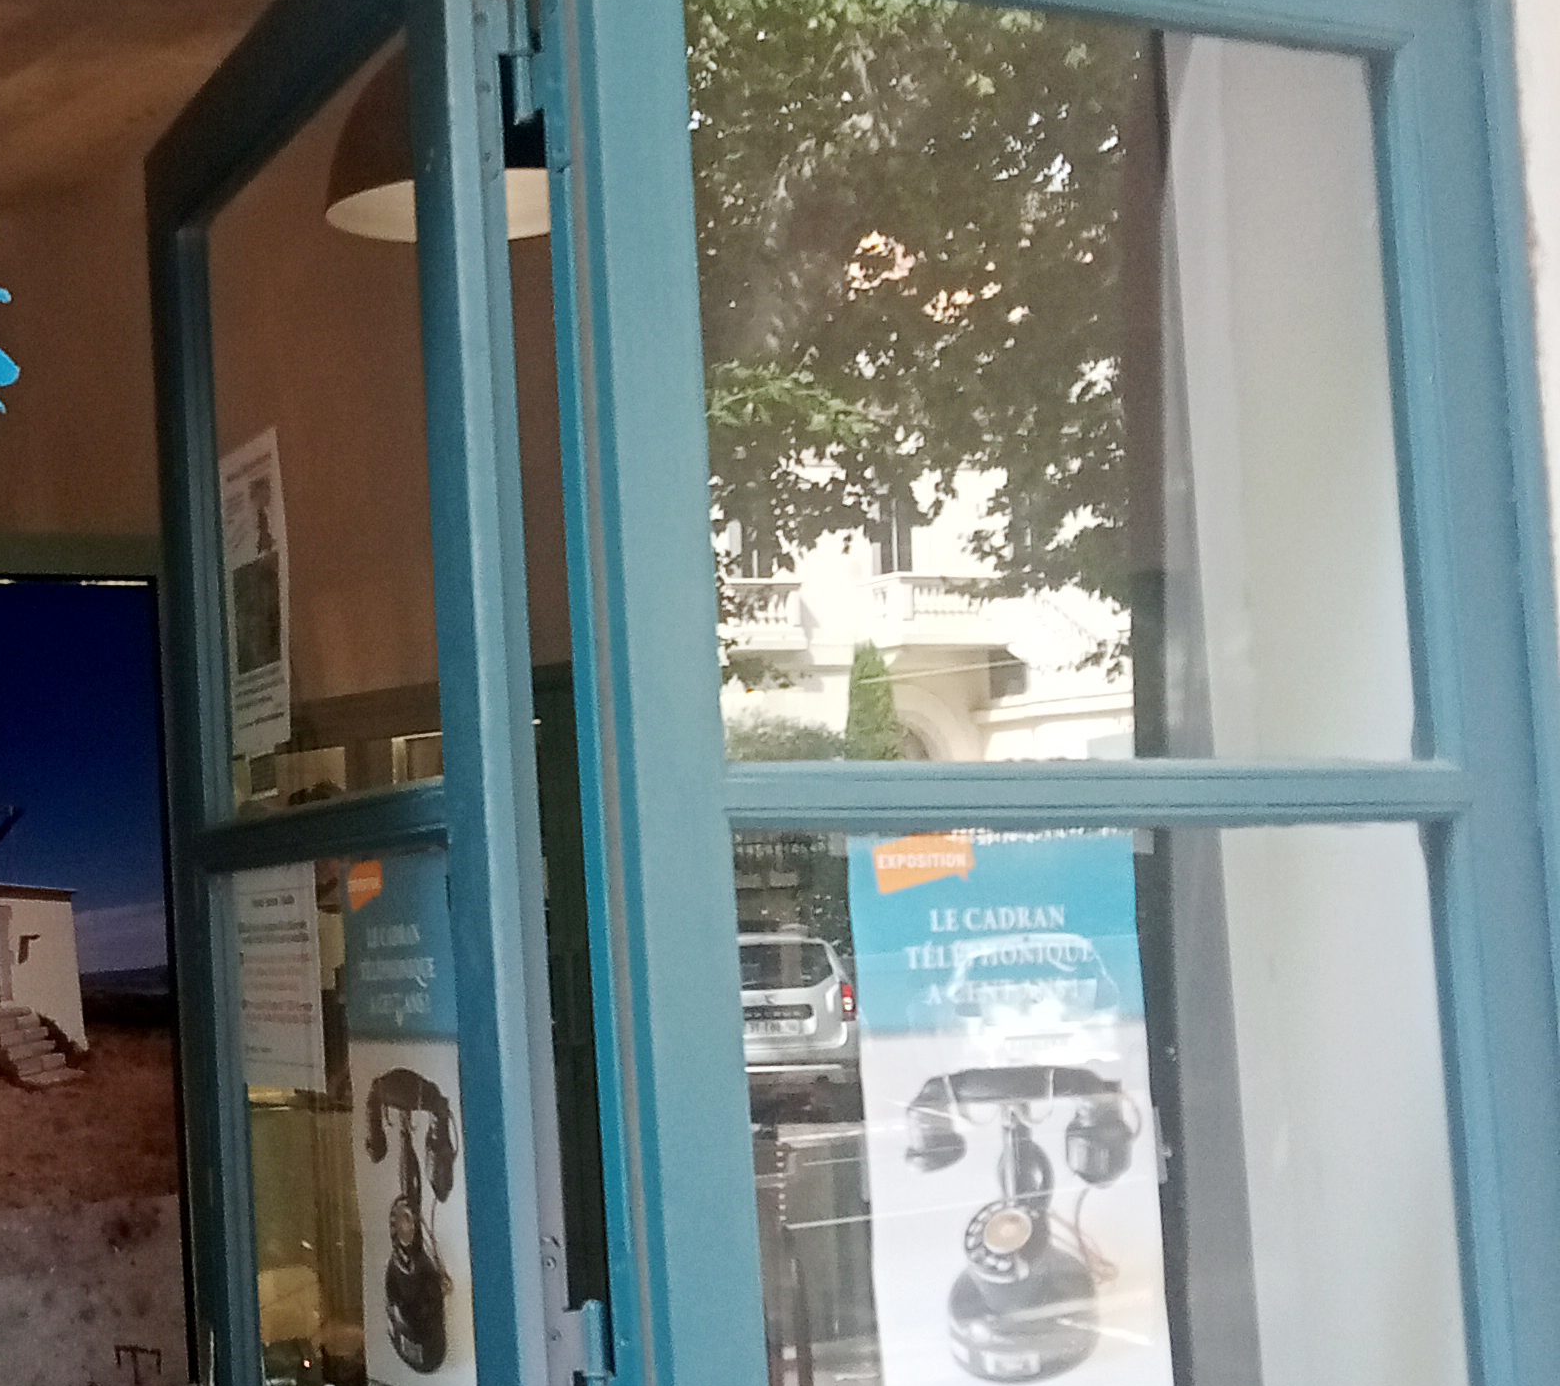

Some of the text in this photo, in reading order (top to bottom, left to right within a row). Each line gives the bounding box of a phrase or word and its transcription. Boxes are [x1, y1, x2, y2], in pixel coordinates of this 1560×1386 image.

[875, 853, 968, 871] EXPOSITION
[930, 903, 1065, 934] LE CADRAN
[905, 939, 1096, 972] TÉLÉPHONIQUE
